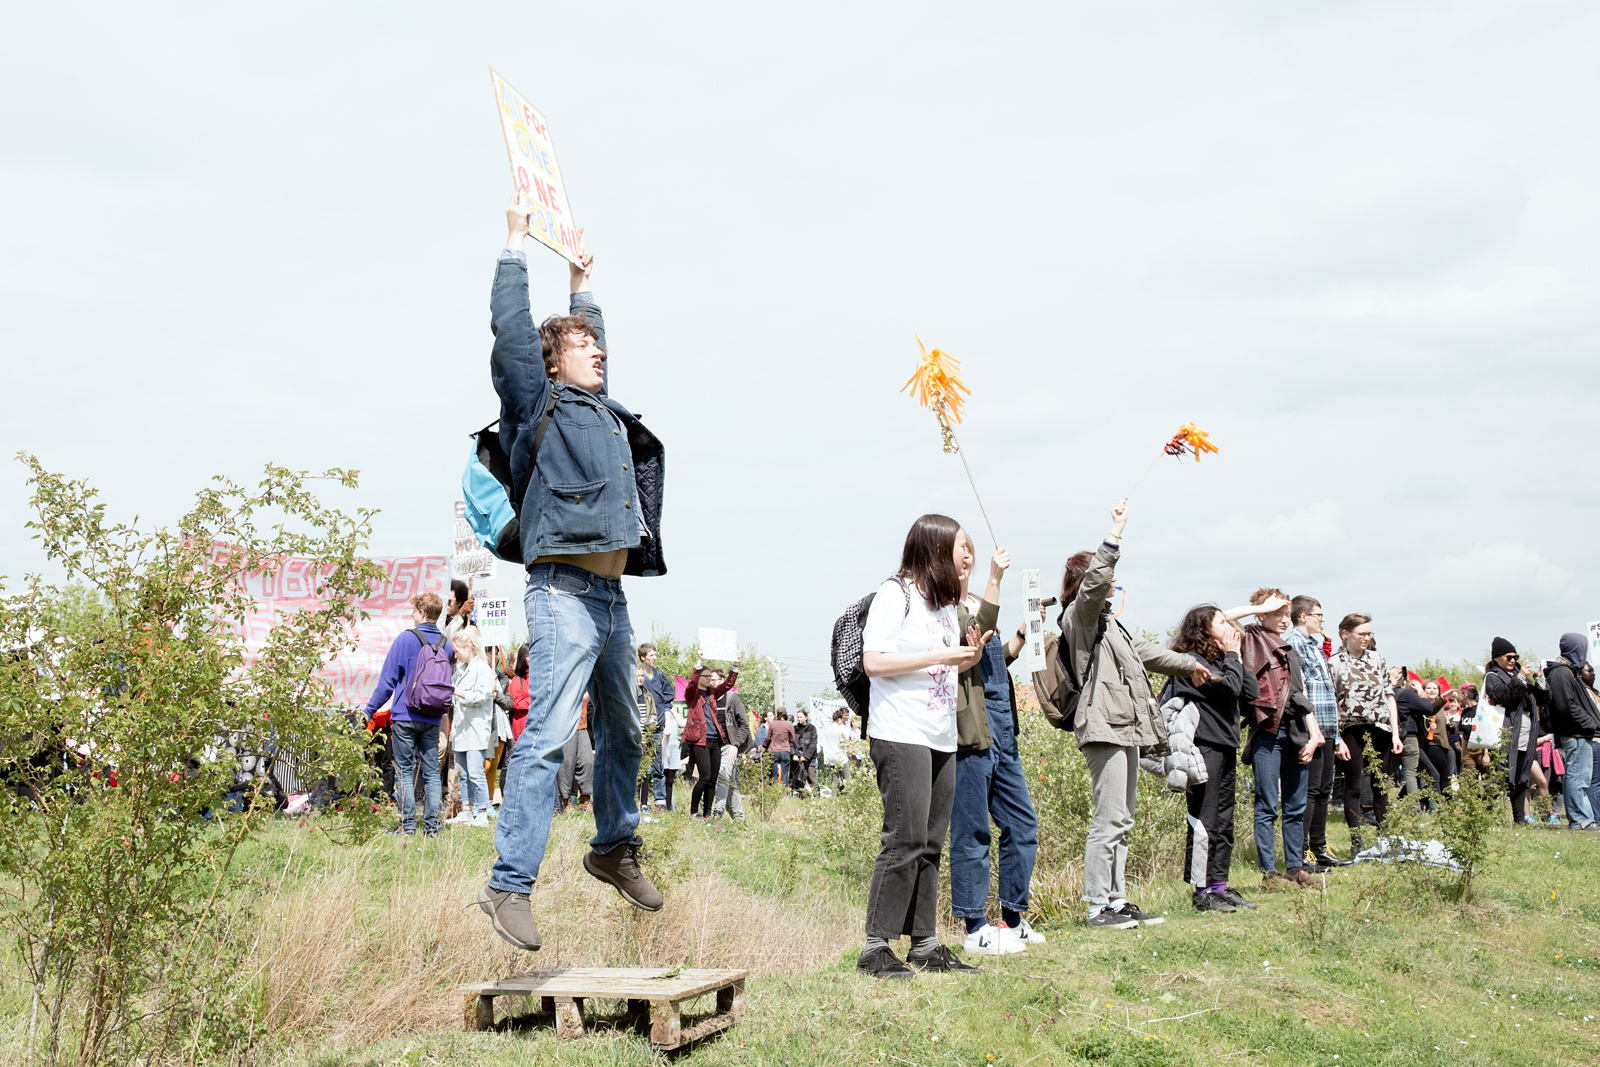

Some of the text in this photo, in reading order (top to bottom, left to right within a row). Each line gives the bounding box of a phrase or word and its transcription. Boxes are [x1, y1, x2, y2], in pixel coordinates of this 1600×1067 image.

[515, 128, 554, 178] ONE
[455, 552, 493, 576] ABUSE
[481, 600, 507, 609] #SET
[487, 609, 507, 618] HER
[482, 618, 507, 627] FREE
